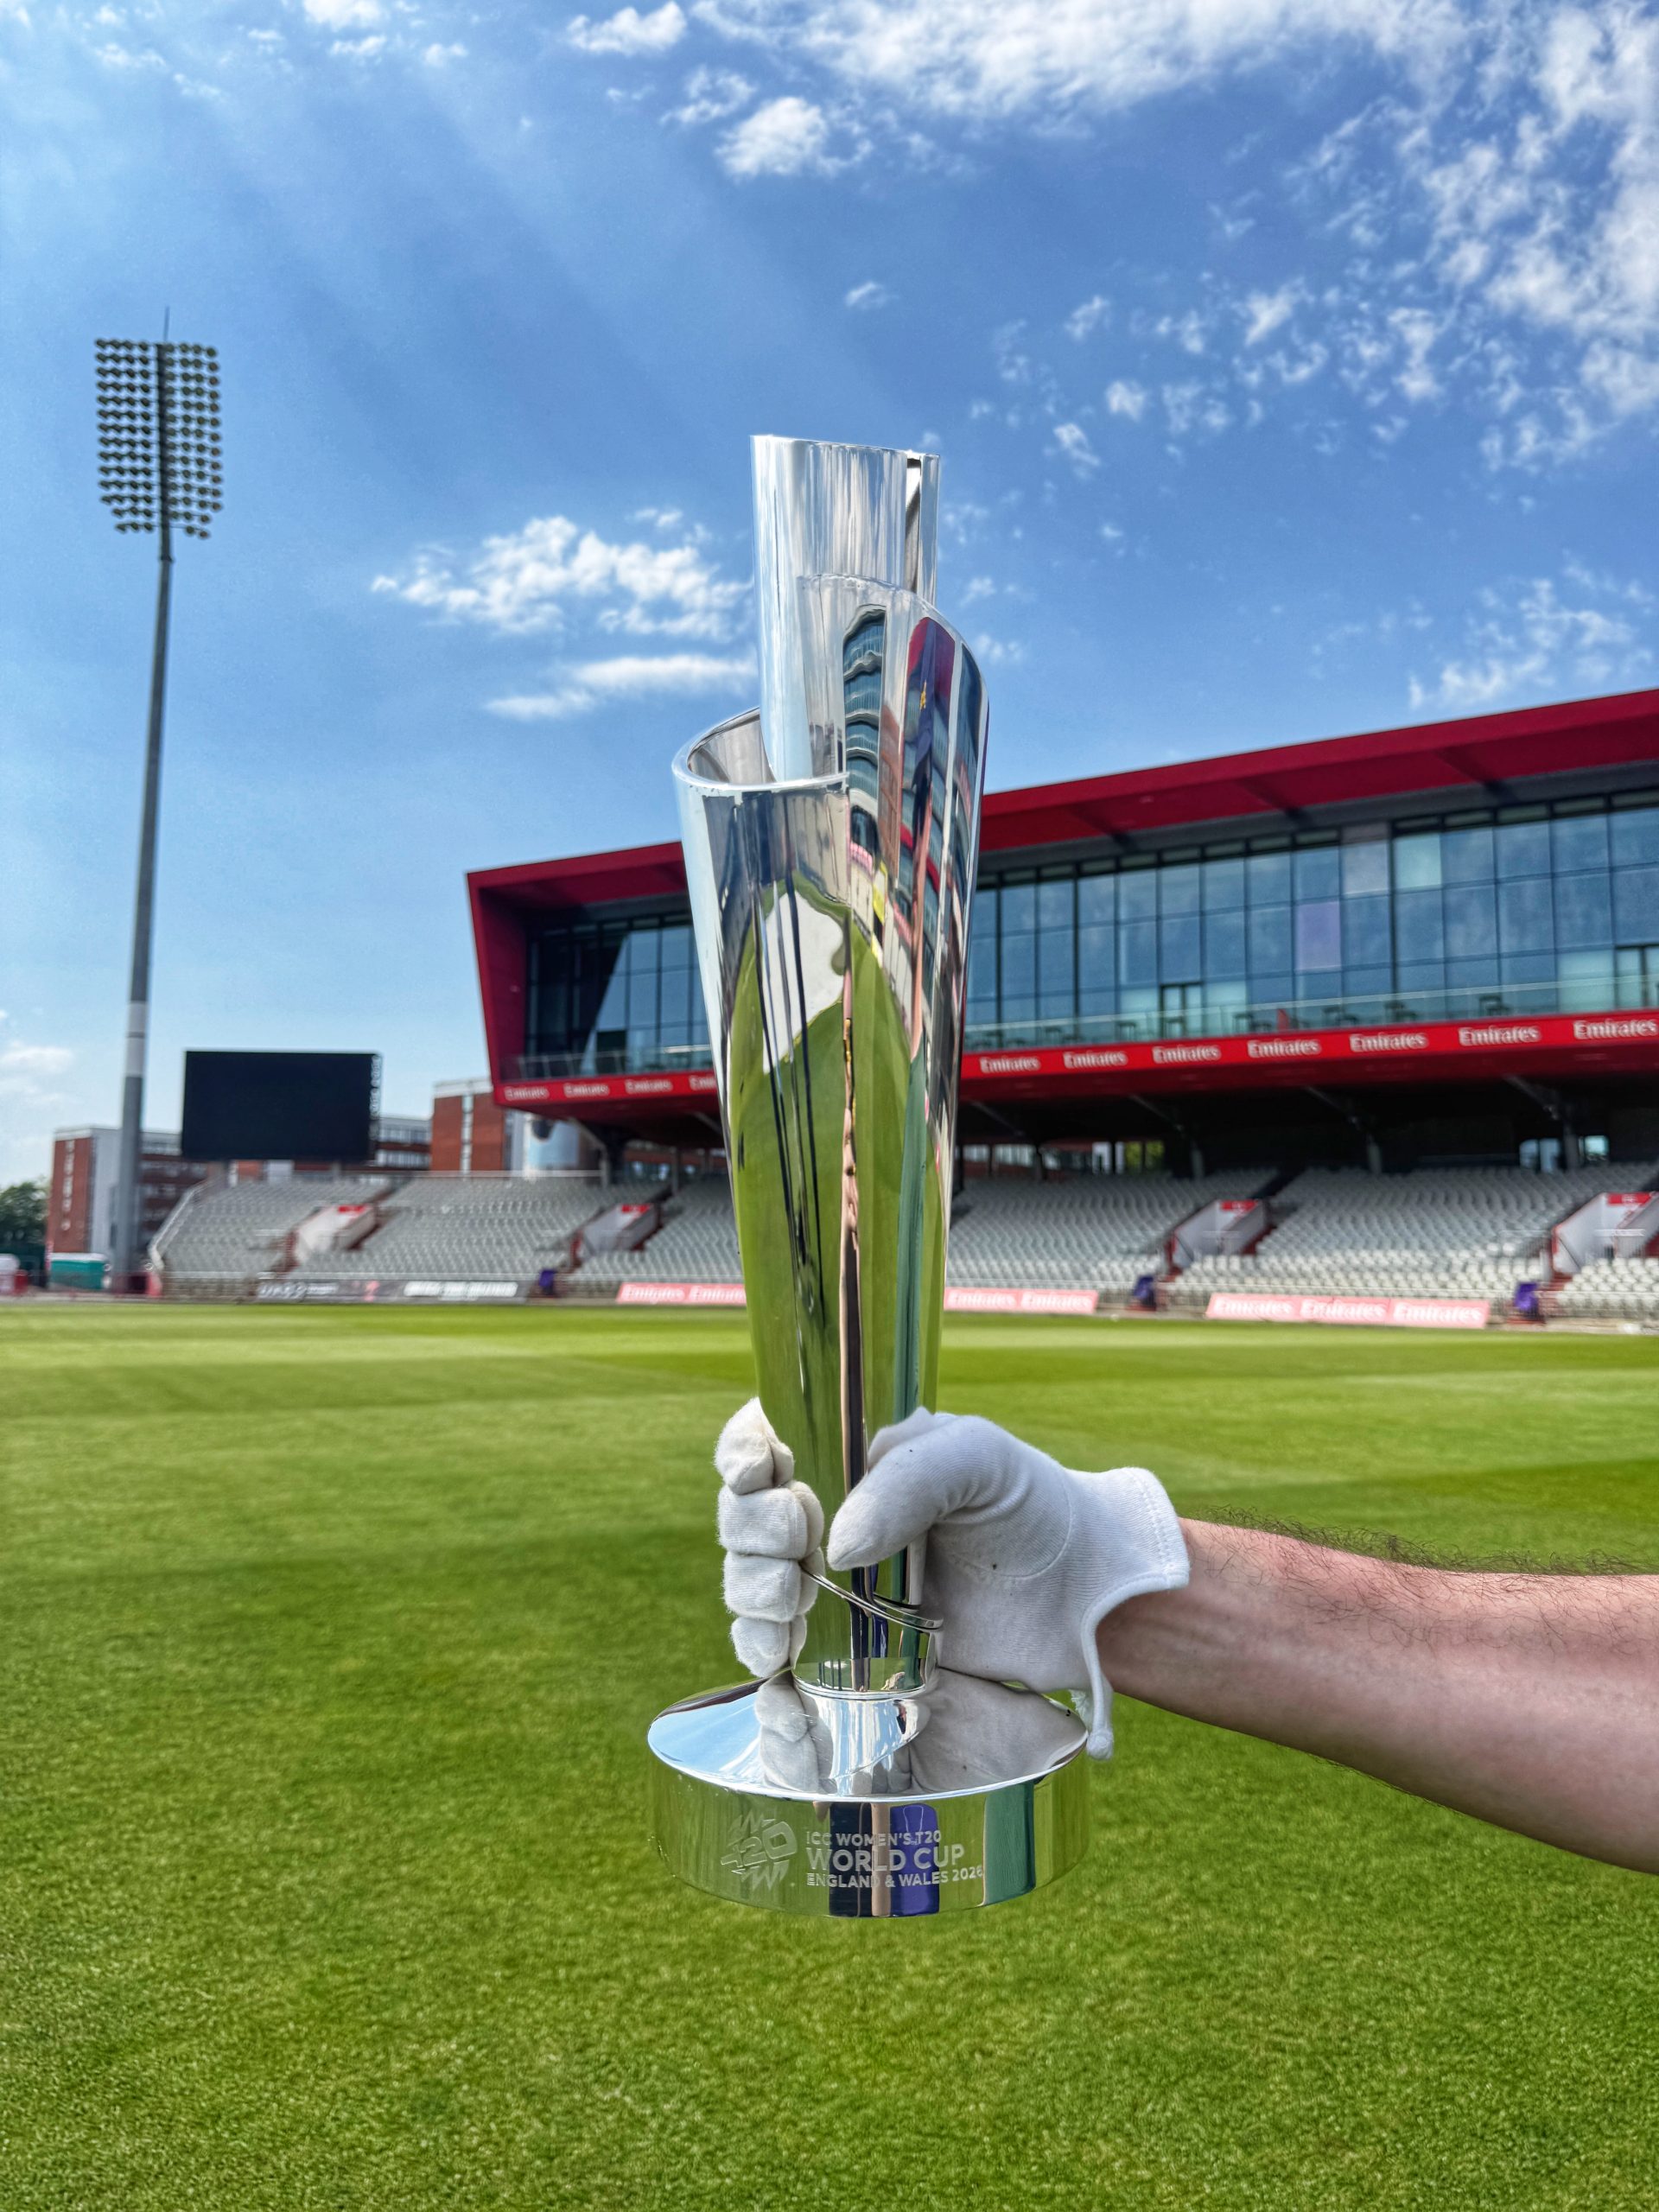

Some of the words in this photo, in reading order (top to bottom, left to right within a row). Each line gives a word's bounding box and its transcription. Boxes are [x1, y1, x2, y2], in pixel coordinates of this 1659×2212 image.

[1459, 1024, 1541, 1047] Emirates
[1573, 1019, 1657, 1040] Emirates
[1247, 1039, 1321, 1059] Emirates
[1349, 1031, 1428, 1053] Emirates
[979, 1056, 1040, 1074] Emirates
[1063, 1050, 1128, 1070] Emirates
[1152, 1045, 1220, 1065] Emirates
[1213, 1297, 1293, 1317] Emirates
[1300, 1299, 1386, 1322] Emirates
[1394, 1302, 1483, 1325] Emirates
[806, 1831, 832, 1846] ICC
[836, 1833, 912, 1847] WOMEN'S
[915, 1830, 942, 1843] T20
[805, 1847, 906, 1872] WORLD
[913, 1844, 965, 1869] CUP
[807, 1872, 880, 1888] ENGLAND
[884, 1874, 896, 1888] &
[899, 1872, 949, 1886] WALES
[952, 1865, 983, 1881] 2026
